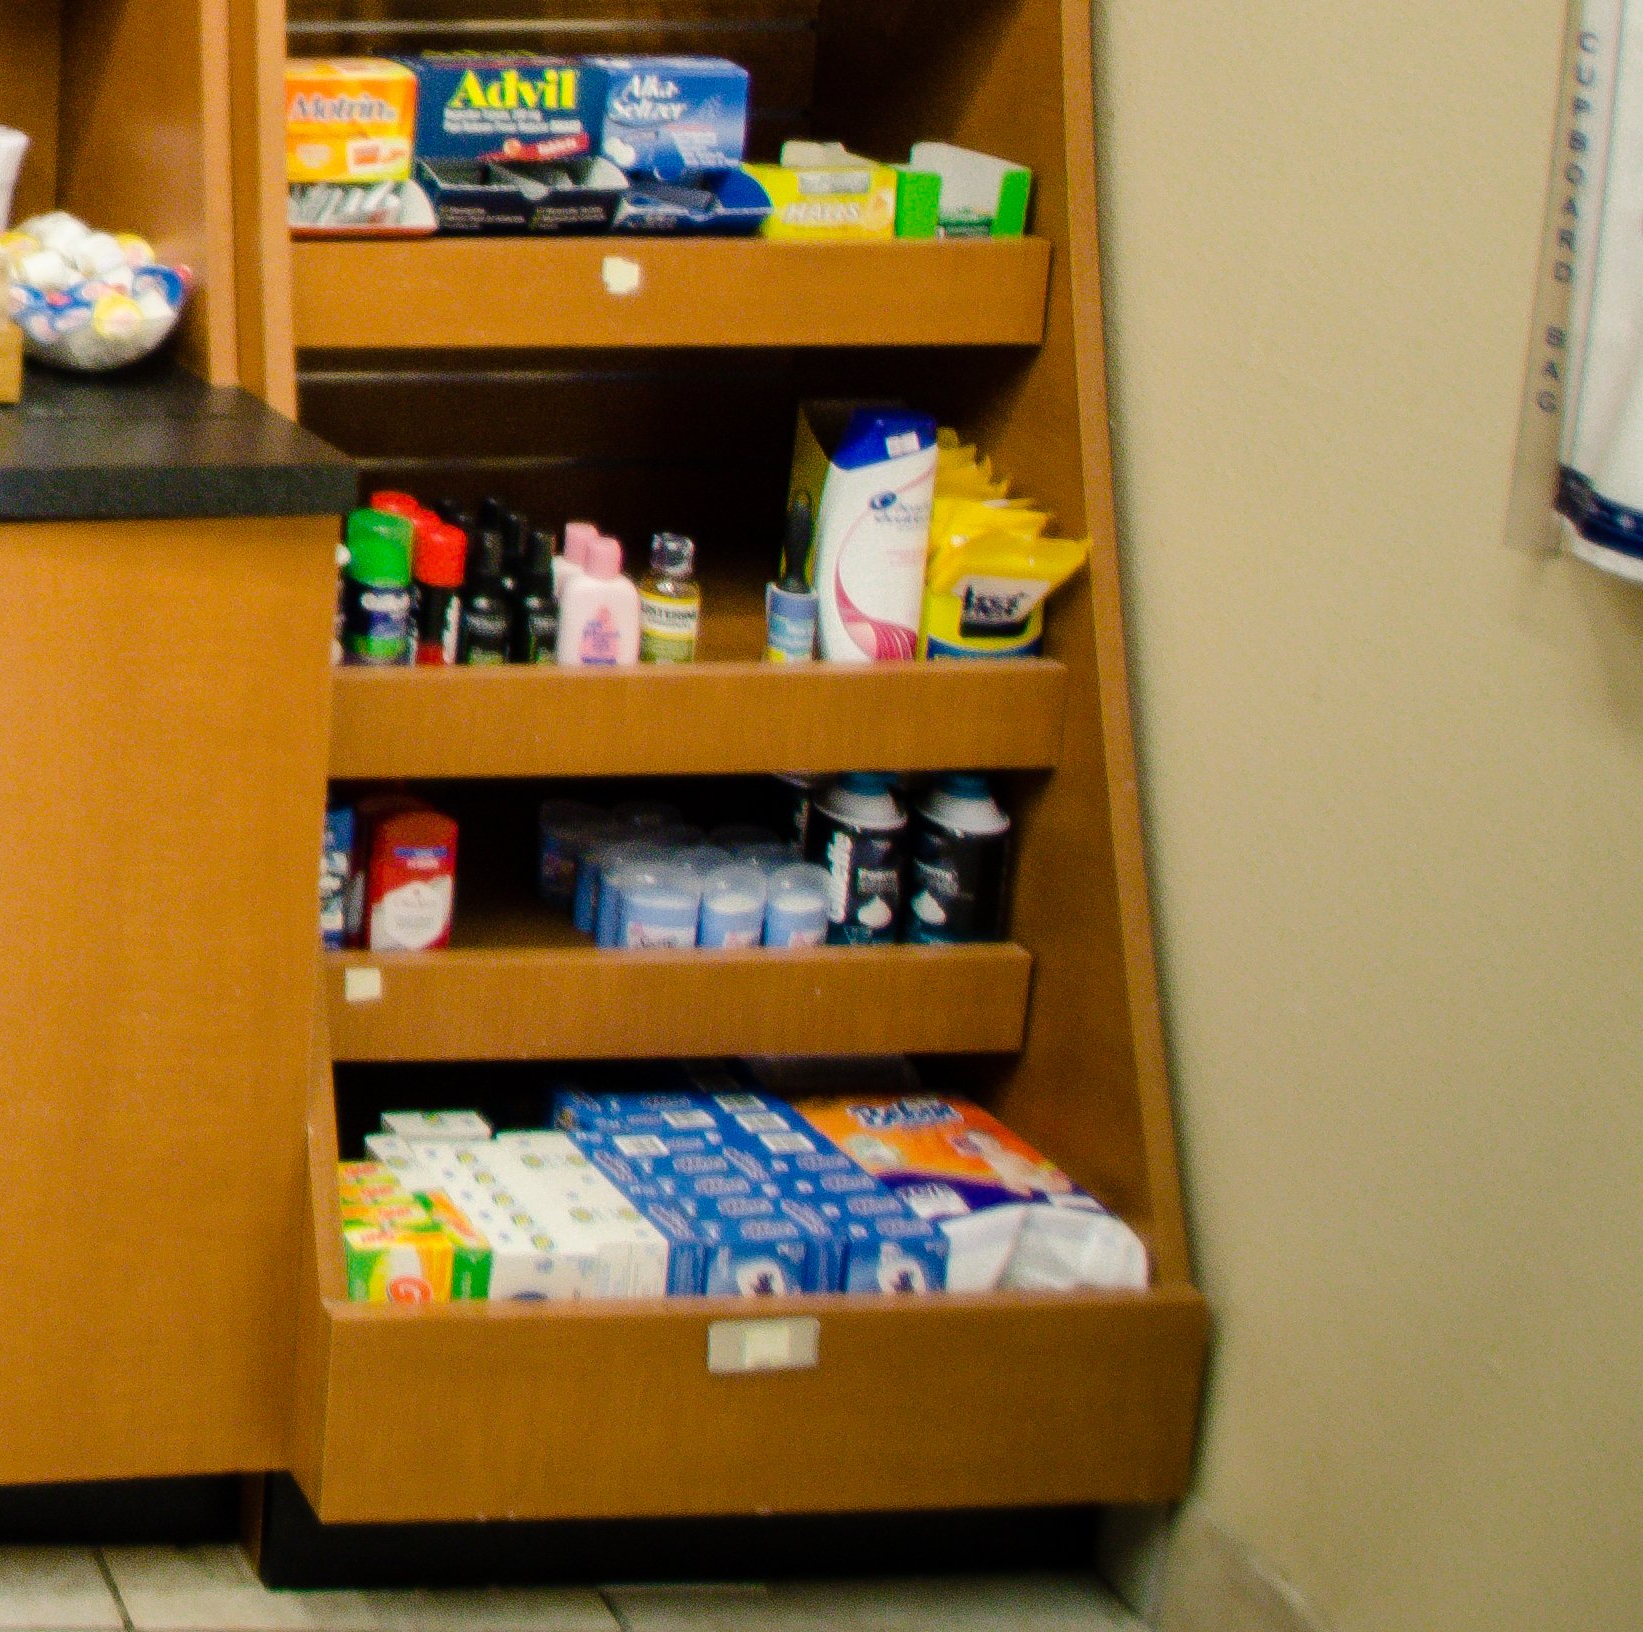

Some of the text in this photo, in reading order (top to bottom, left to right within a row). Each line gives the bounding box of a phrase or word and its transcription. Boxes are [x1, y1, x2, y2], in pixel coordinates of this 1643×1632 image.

[446, 67, 578, 111] Advil
[1536, 30, 1598, 415] CUPBOARD BAG
